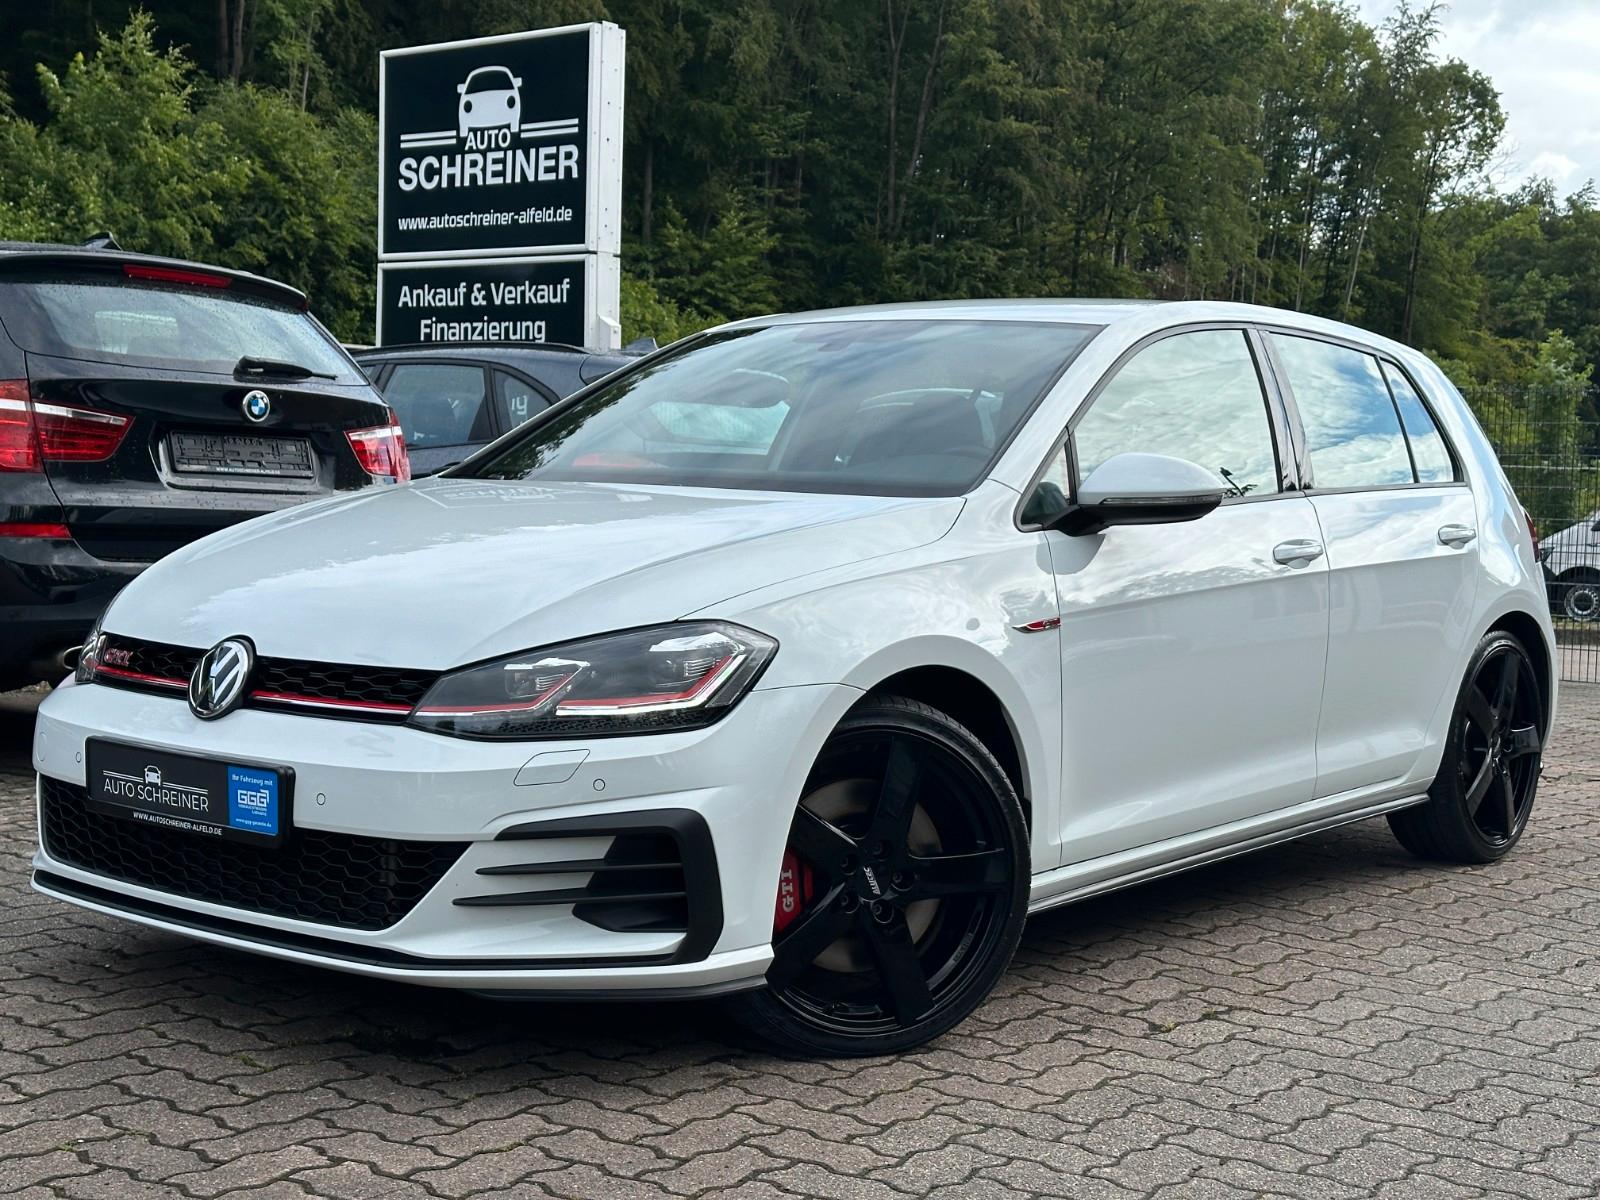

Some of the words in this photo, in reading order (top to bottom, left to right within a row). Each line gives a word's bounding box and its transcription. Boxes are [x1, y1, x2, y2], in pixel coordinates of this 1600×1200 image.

[465, 128, 511, 150] AUTO
[398, 144, 579, 191] SCHREINER
[398, 206, 572, 230] www.autoschreiner-alfeld.de
[398, 282, 467, 308] Ankauf
[471, 283, 486, 306] &
[491, 278, 570, 305] Verkauf
[420, 316, 546, 343] Finanzierung
[103, 777, 135, 797] AUTO
[137, 785, 209, 812] SCHREINER
[133, 810, 222, 836] WWW.AUTOSCHREINER-ALFELD.DE
[781, 869, 794, 912] GTI
